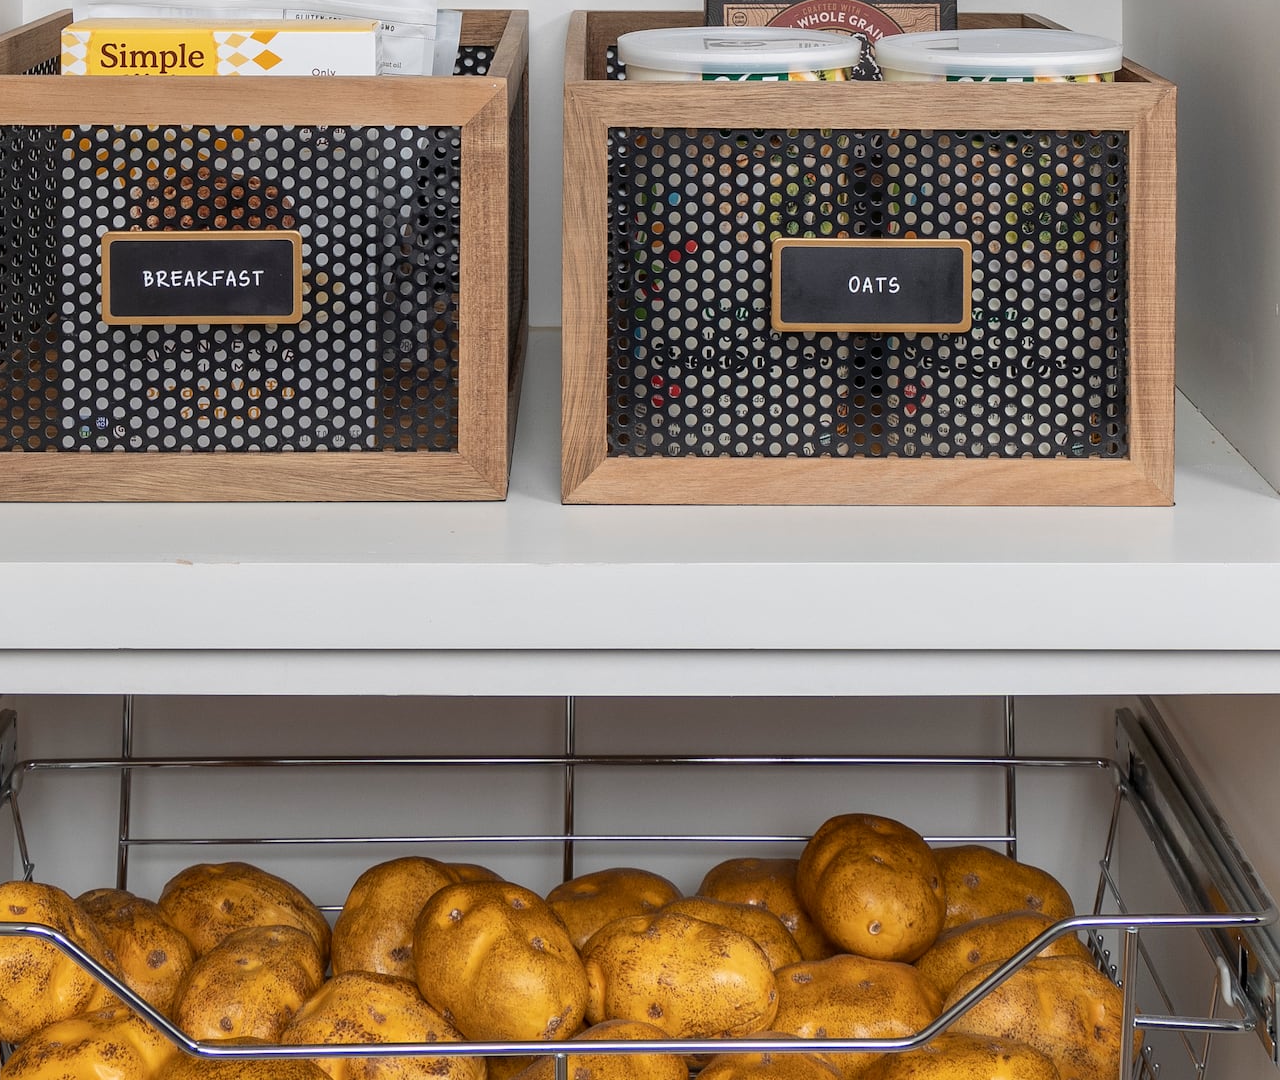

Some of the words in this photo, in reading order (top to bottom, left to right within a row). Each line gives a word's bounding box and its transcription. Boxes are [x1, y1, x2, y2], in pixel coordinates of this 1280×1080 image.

[802, 2, 837, 16] CRAFTED
[840, 3, 861, 16] WITH
[796, 11, 846, 29] WHOLE
[100, 42, 205, 74] Simple
[142, 269, 265, 288] BREAKFAST
[848, 275, 901, 294] OATS
